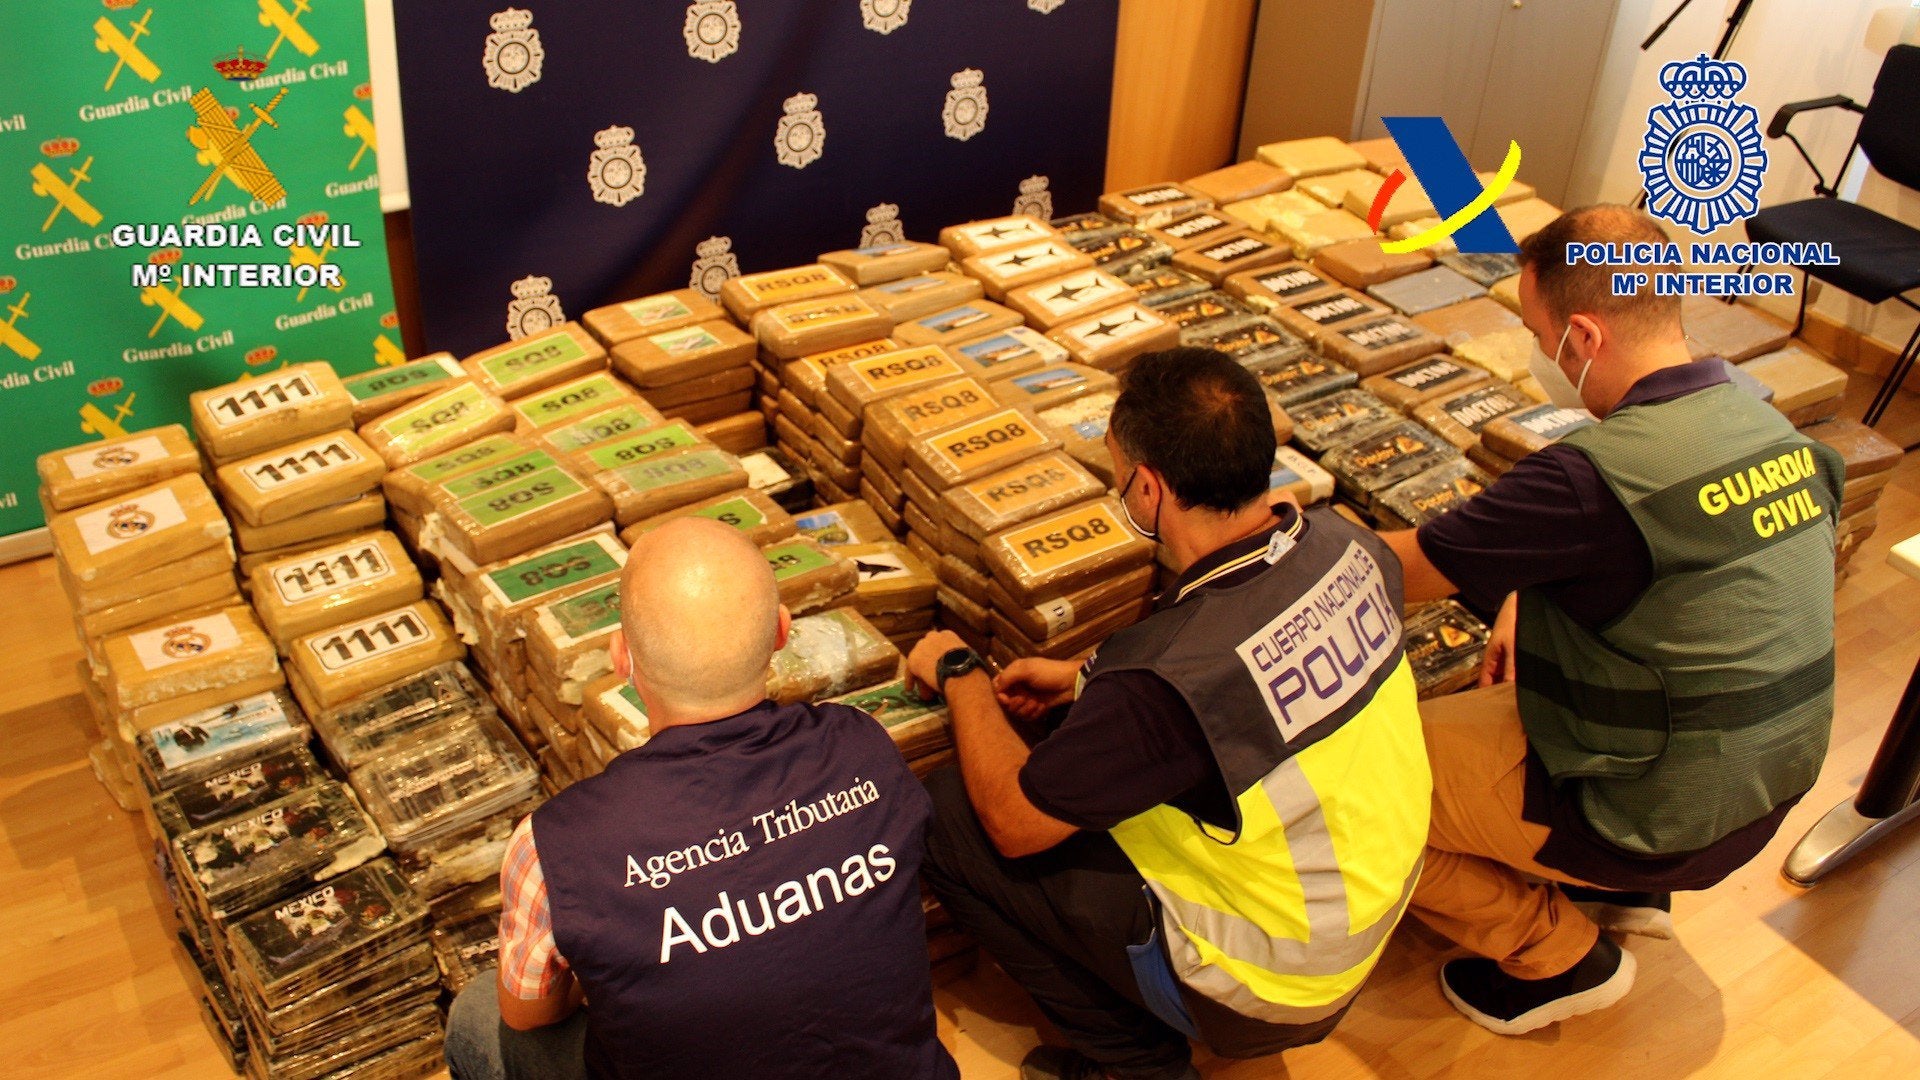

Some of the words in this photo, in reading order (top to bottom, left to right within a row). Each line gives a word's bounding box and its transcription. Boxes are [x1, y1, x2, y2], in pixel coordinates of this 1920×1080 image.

[240, 67, 307, 92] Guardia
[309, 60, 348, 80] Civil
[79, 98, 150, 123] Guardia
[153, 86, 192, 109] Civil
[0, 114, 27, 132] ivil
[325, 173, 379, 198] Guardi
[15, 237, 91, 261] Guardia
[757, 273, 828, 293] RSQ8
[1260, 269, 1321, 293] DOCTOR
[275, 304, 337, 331] Guardia
[339, 292, 375, 315] Civil
[1300, 297, 1364, 322] DOCTOR
[122, 341, 194, 364] Guardia
[196, 330, 235, 353] Civil
[504, 344, 563, 371] SQ8
[33, 360, 75, 383] Civil
[866, 354, 943, 381] RSQ8
[1395, 361, 1461, 388] DOCTOR
[217, 377, 312, 418] 1111
[541, 386, 600, 413] SQ8
[902, 389, 980, 423] RSQ8
[1450, 394, 1518, 428] DOCTOR
[948, 422, 1027, 458] RSQ8
[254, 443, 352, 483] 1111
[985, 468, 1067, 503] RSQ8
[1698, 446, 1817, 516] GUARDIA
[1752, 488, 1822, 539] CIVIL
[1022, 518, 1112, 559] RSQ8
[283, 548, 383, 594] 1111
[1250, 606, 1322, 673] CUERPO
[1313, 565, 1367, 623] NACIONAL
[321, 613, 423, 662] 1111
[1268, 582, 1398, 726] POLICIA
[205, 762, 263, 789] MEXICO
[222, 807, 284, 838] MEXICO
[624, 828, 750, 890] Agencia
[752, 776, 880, 845] Tributaria
[274, 885, 336, 921] MEXICO
[660, 843, 897, 965] Aduanas
